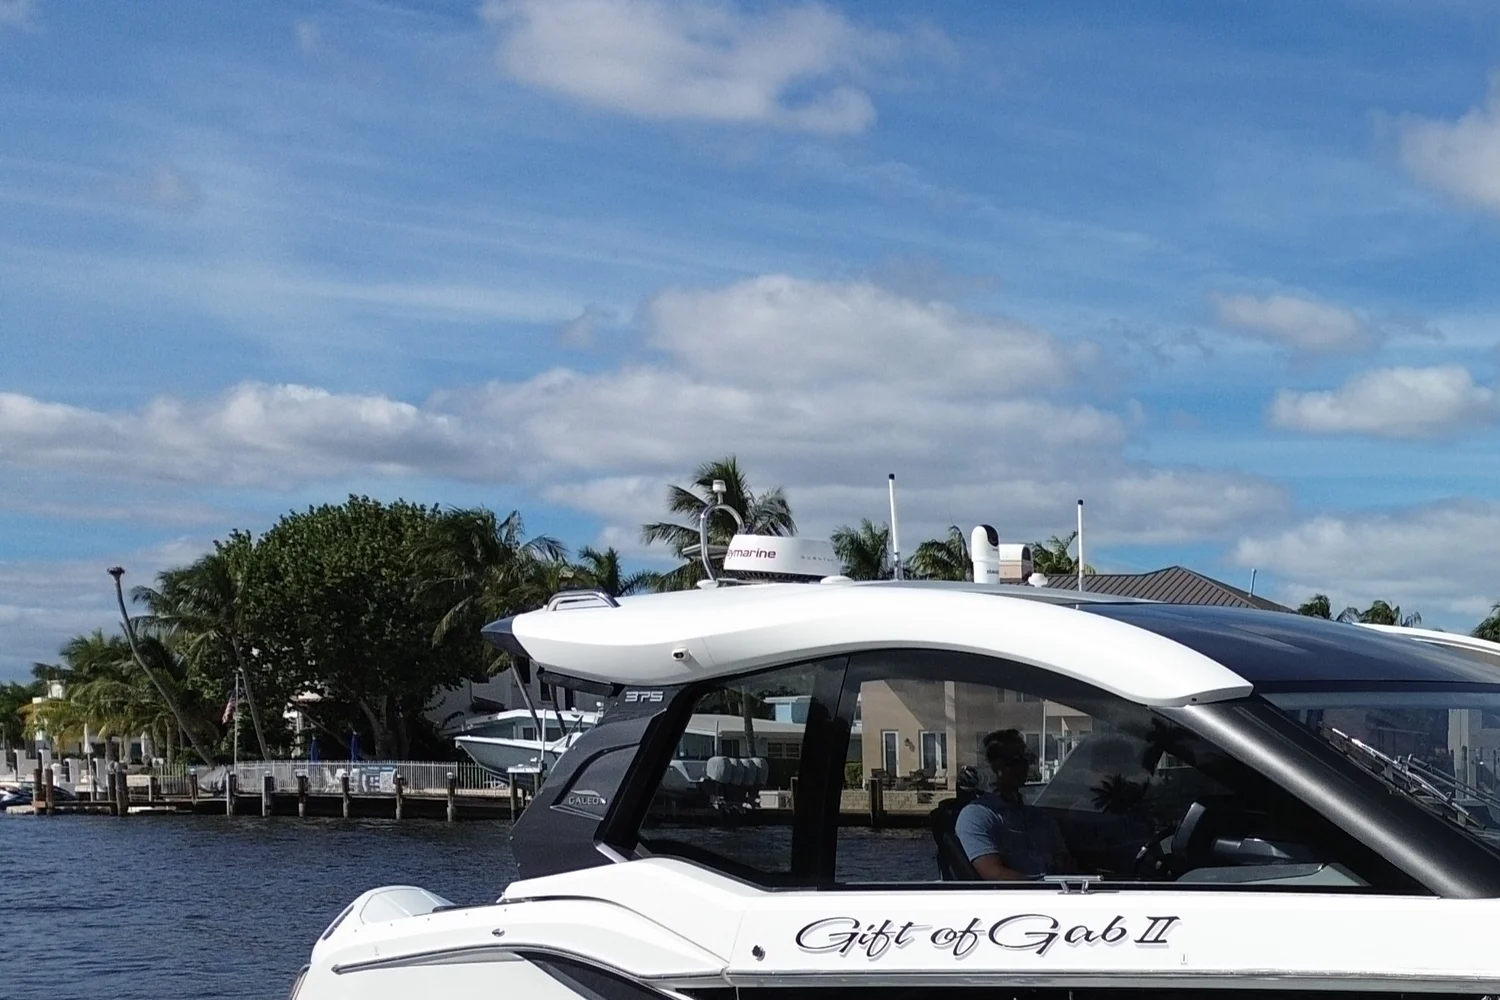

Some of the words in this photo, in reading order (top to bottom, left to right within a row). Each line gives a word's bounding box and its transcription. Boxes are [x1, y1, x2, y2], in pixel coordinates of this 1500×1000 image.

[625, 691, 664, 702] 375
[795, 916, 933, 959] Gift
[930, 917, 986, 958] of
[988, 914, 1129, 956] Gab
[1133, 915, 1181, 945] II
